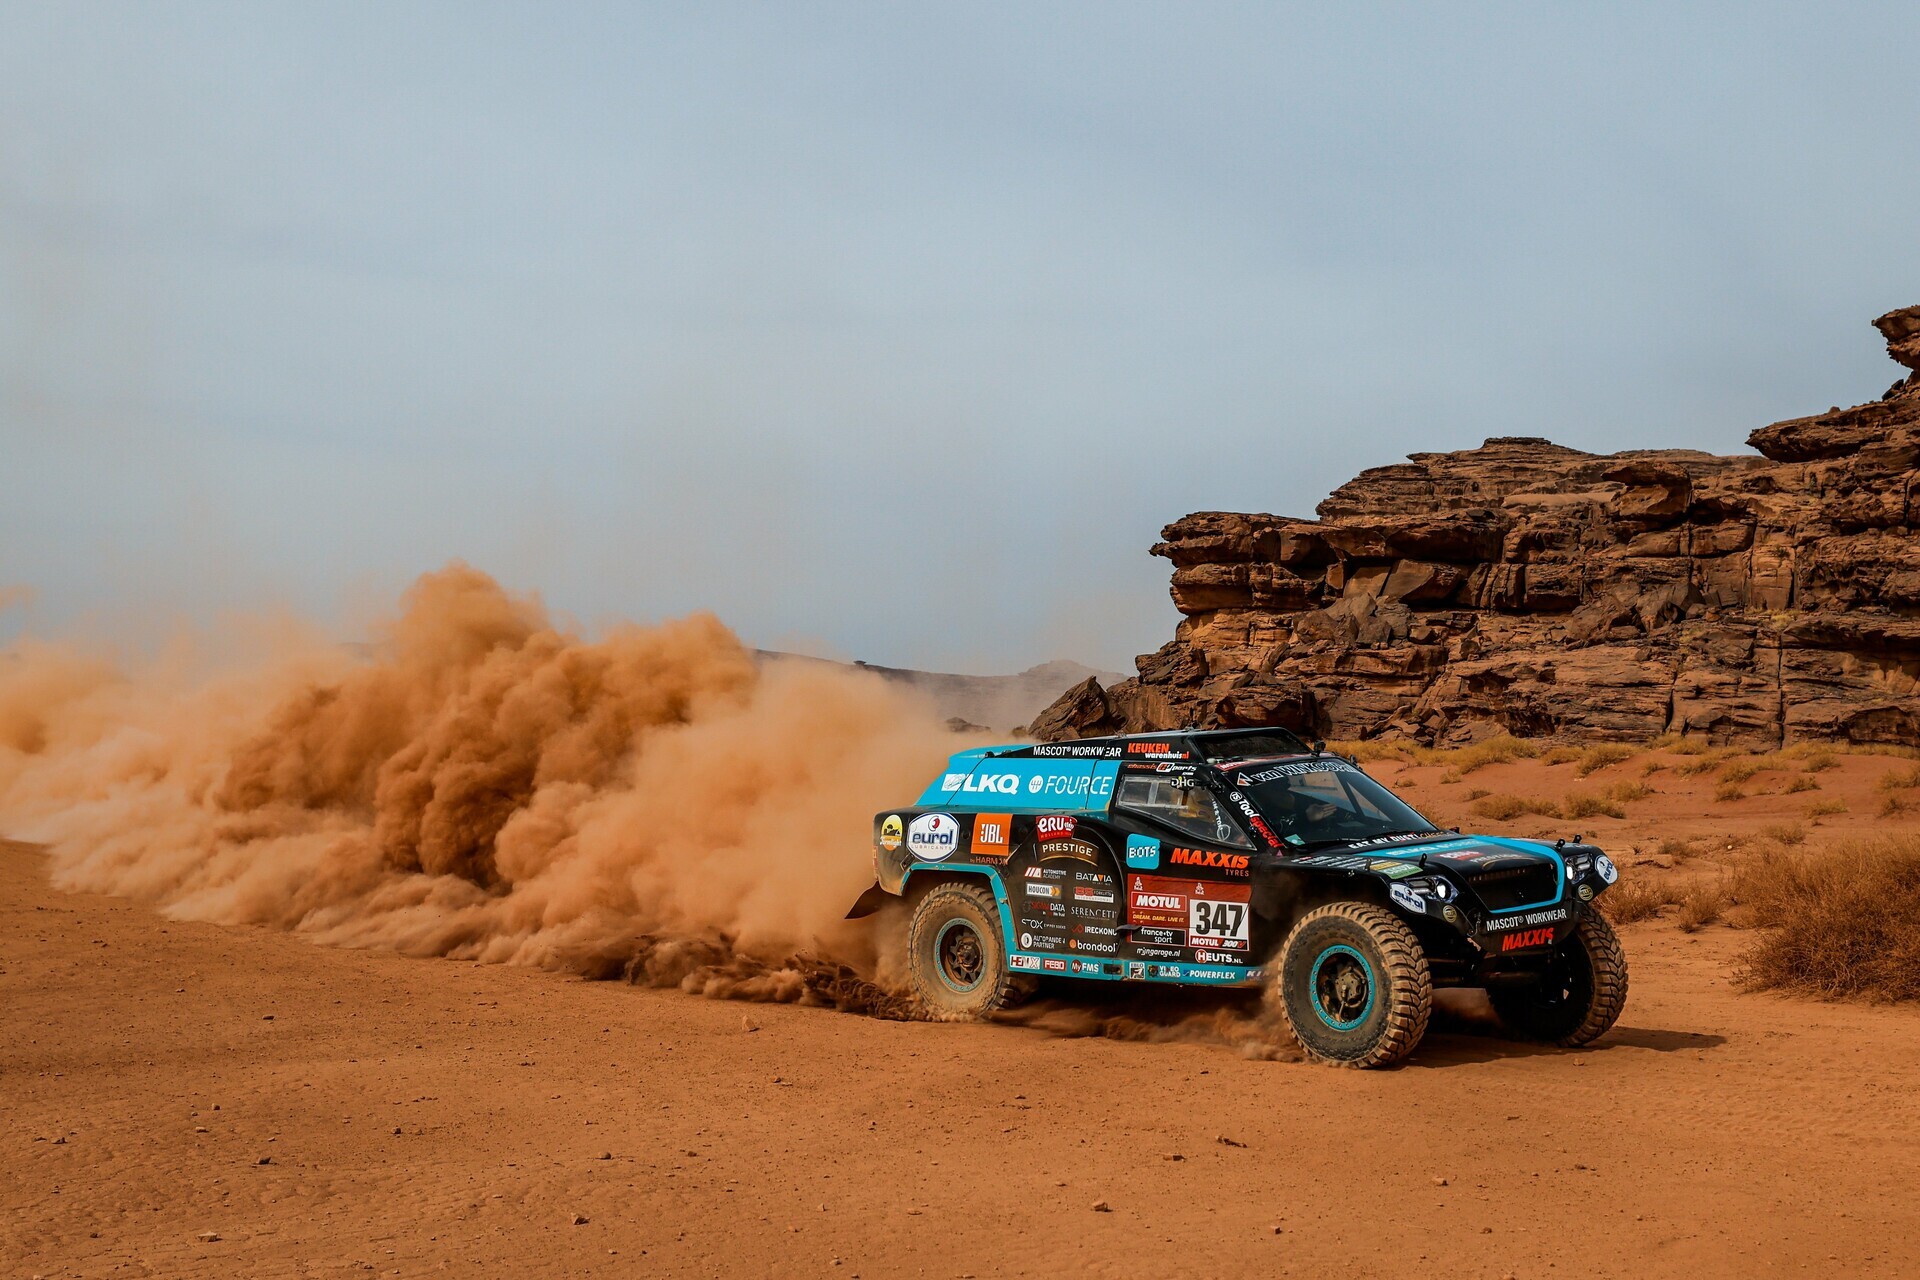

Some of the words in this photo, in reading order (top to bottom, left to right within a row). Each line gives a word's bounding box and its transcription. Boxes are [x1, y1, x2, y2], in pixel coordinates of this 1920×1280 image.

[1072, 747, 1122, 757] WORKWEAR
[1127, 743, 1170, 753] KEUKEN
[962, 774, 1020, 795] LKQ
[1044, 776, 1112, 794] FOURCE
[912, 828, 954, 845] eurol
[980, 824, 1004, 844] JBL
[1042, 843, 1093, 856] PRESTIGE
[1128, 846, 1156, 858] BOTS
[1170, 848, 1252, 869] MAXXIS
[1076, 872, 1112, 882] BATAVIA
[1225, 868, 1250, 876] TYRES
[1028, 886, 1050, 894] HOUCON
[1136, 894, 1181, 908] MOTUL
[1394, 890, 1424, 910] eurol
[1071, 906, 1116, 918] SERENGETI
[1525, 908, 1567, 925] WORKWEAR
[1196, 902, 1243, 937] 347
[1154, 935, 1172, 944] sport
[1191, 938, 1219, 946] MOTUL
[1222, 940, 1246, 948] 300V
[1502, 928, 1554, 952] MAXXIS
[1033, 942, 1054, 950] PARTNER
[1078, 940, 1116, 952] brondool
[1044, 960, 1065, 970] FEBO
[1189, 970, 1236, 980] POWERFLEX
